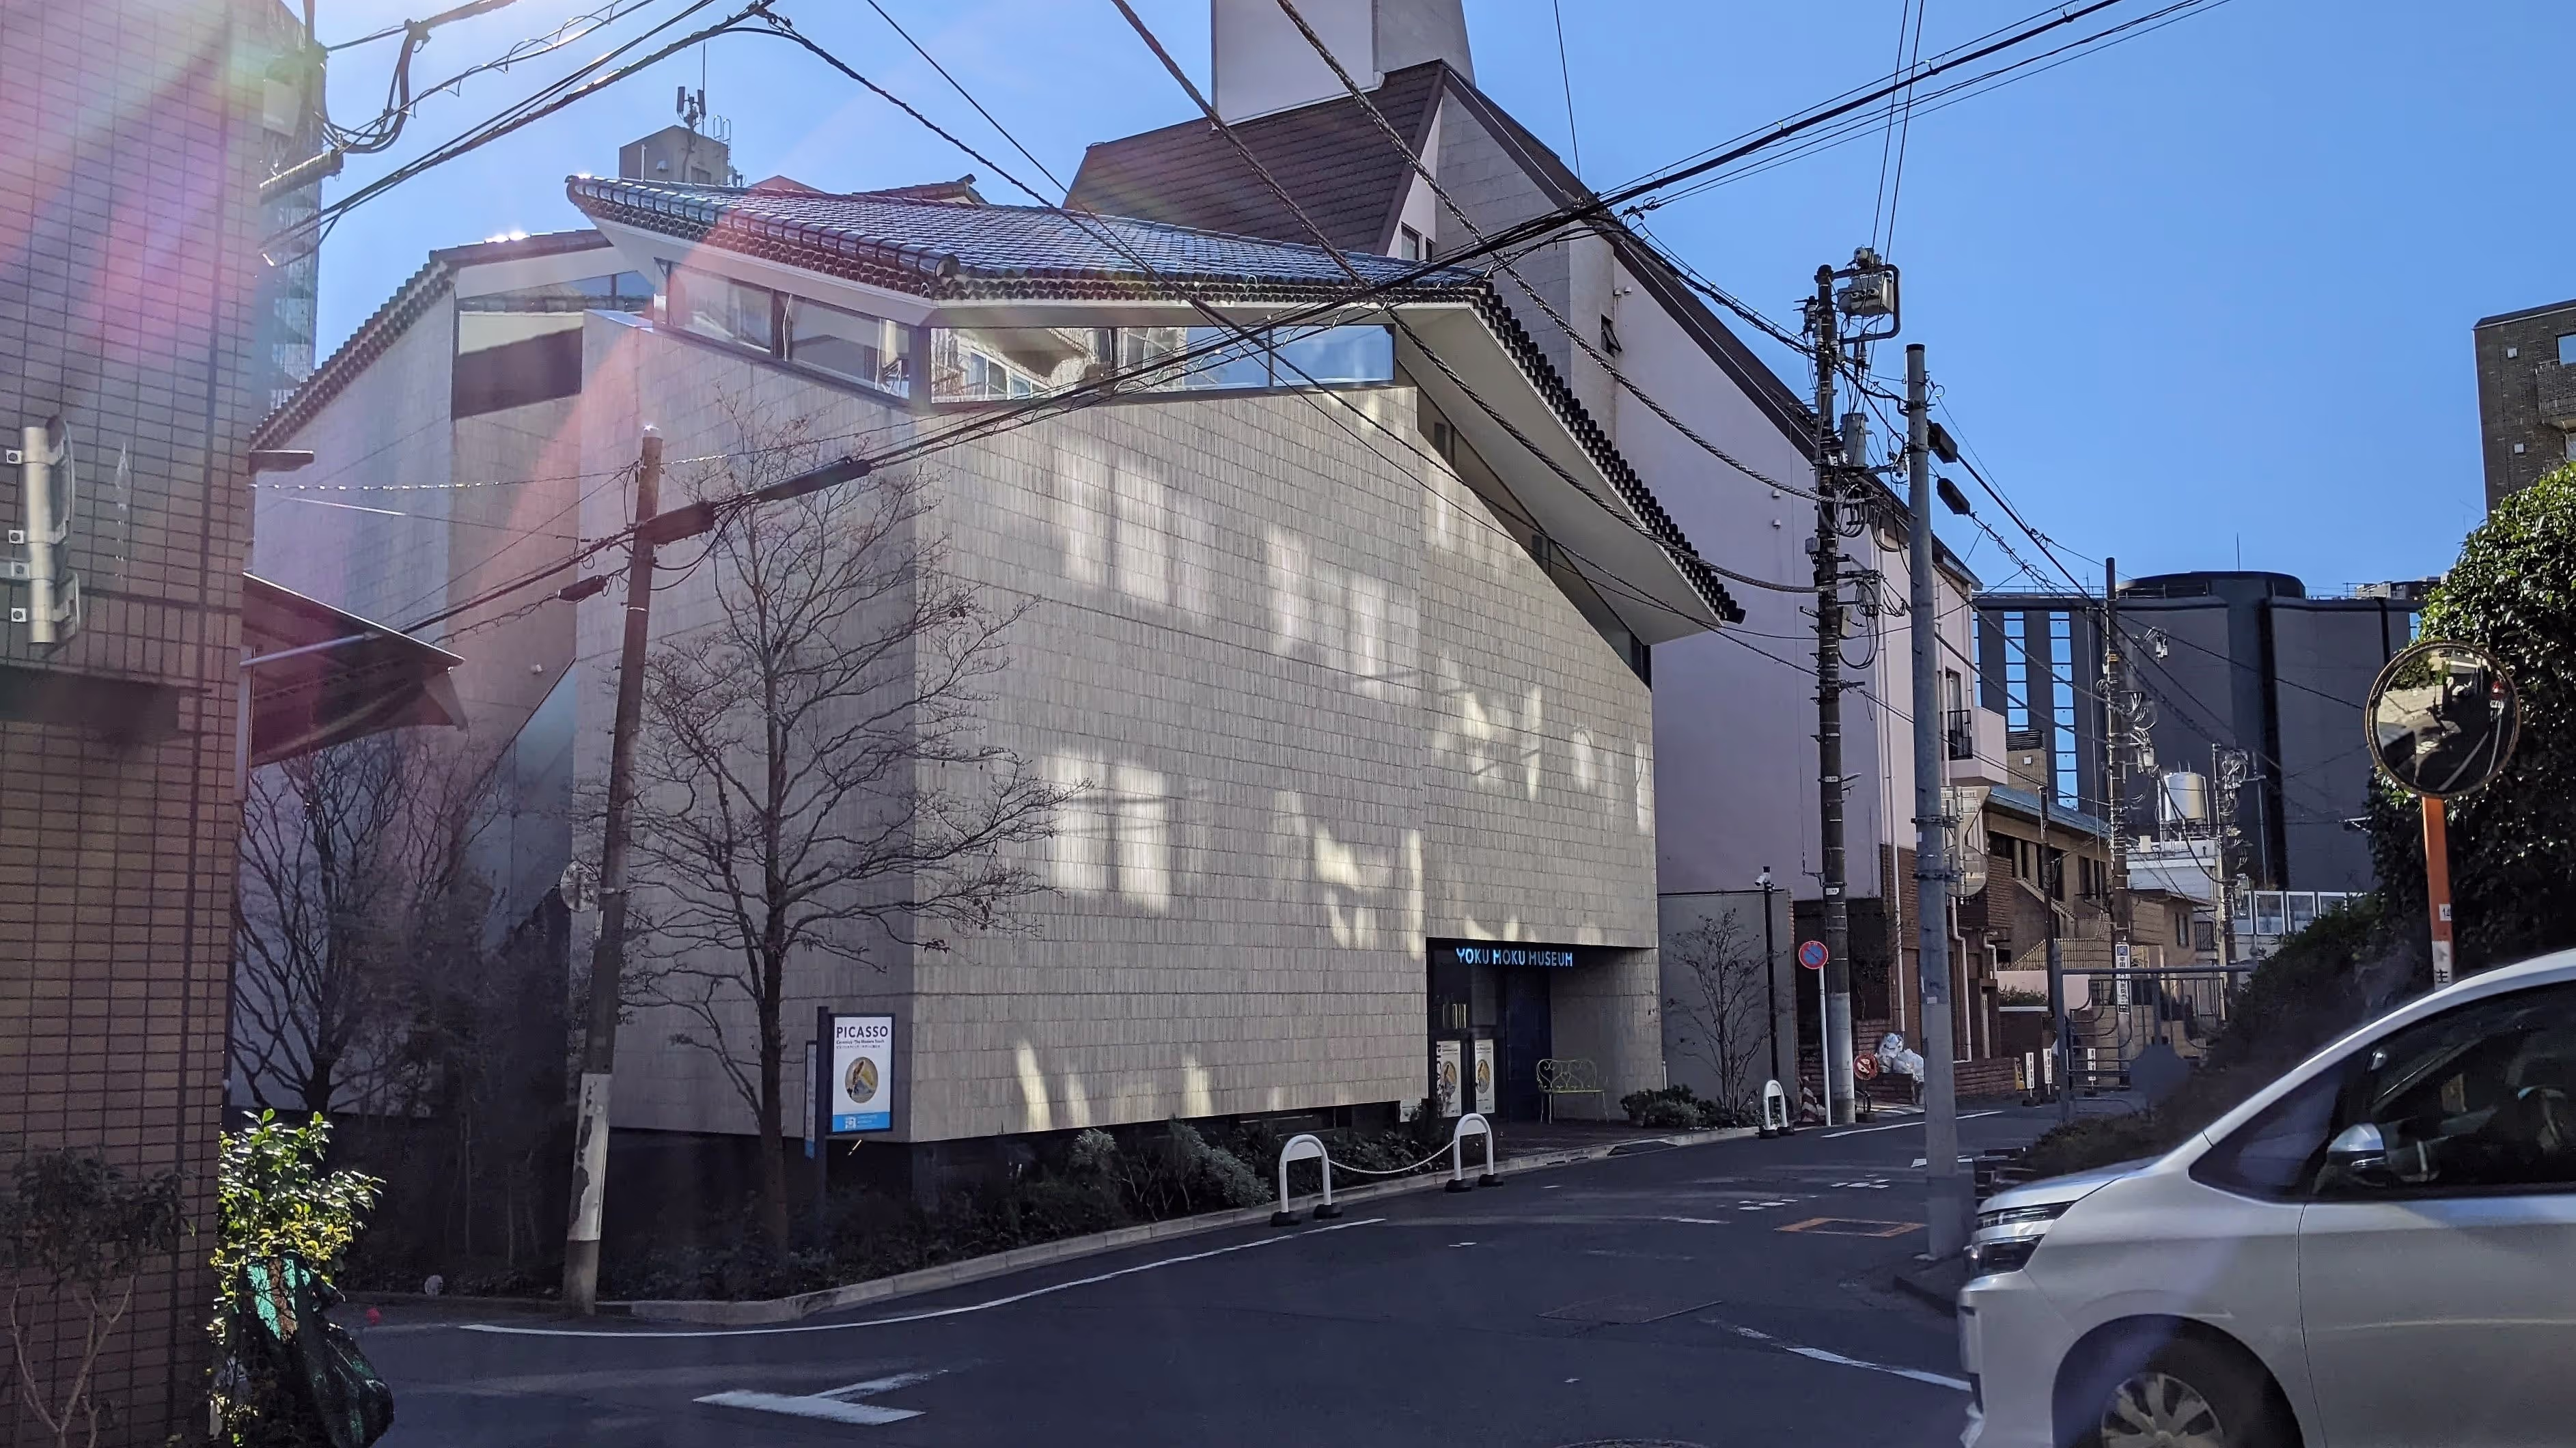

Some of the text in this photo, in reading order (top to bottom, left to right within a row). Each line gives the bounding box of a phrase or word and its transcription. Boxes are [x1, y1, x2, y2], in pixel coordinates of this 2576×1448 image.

[1456, 947, 1573, 967] YOKU MOKU MUSEUM
[836, 1026, 888, 1038] PICASSO
